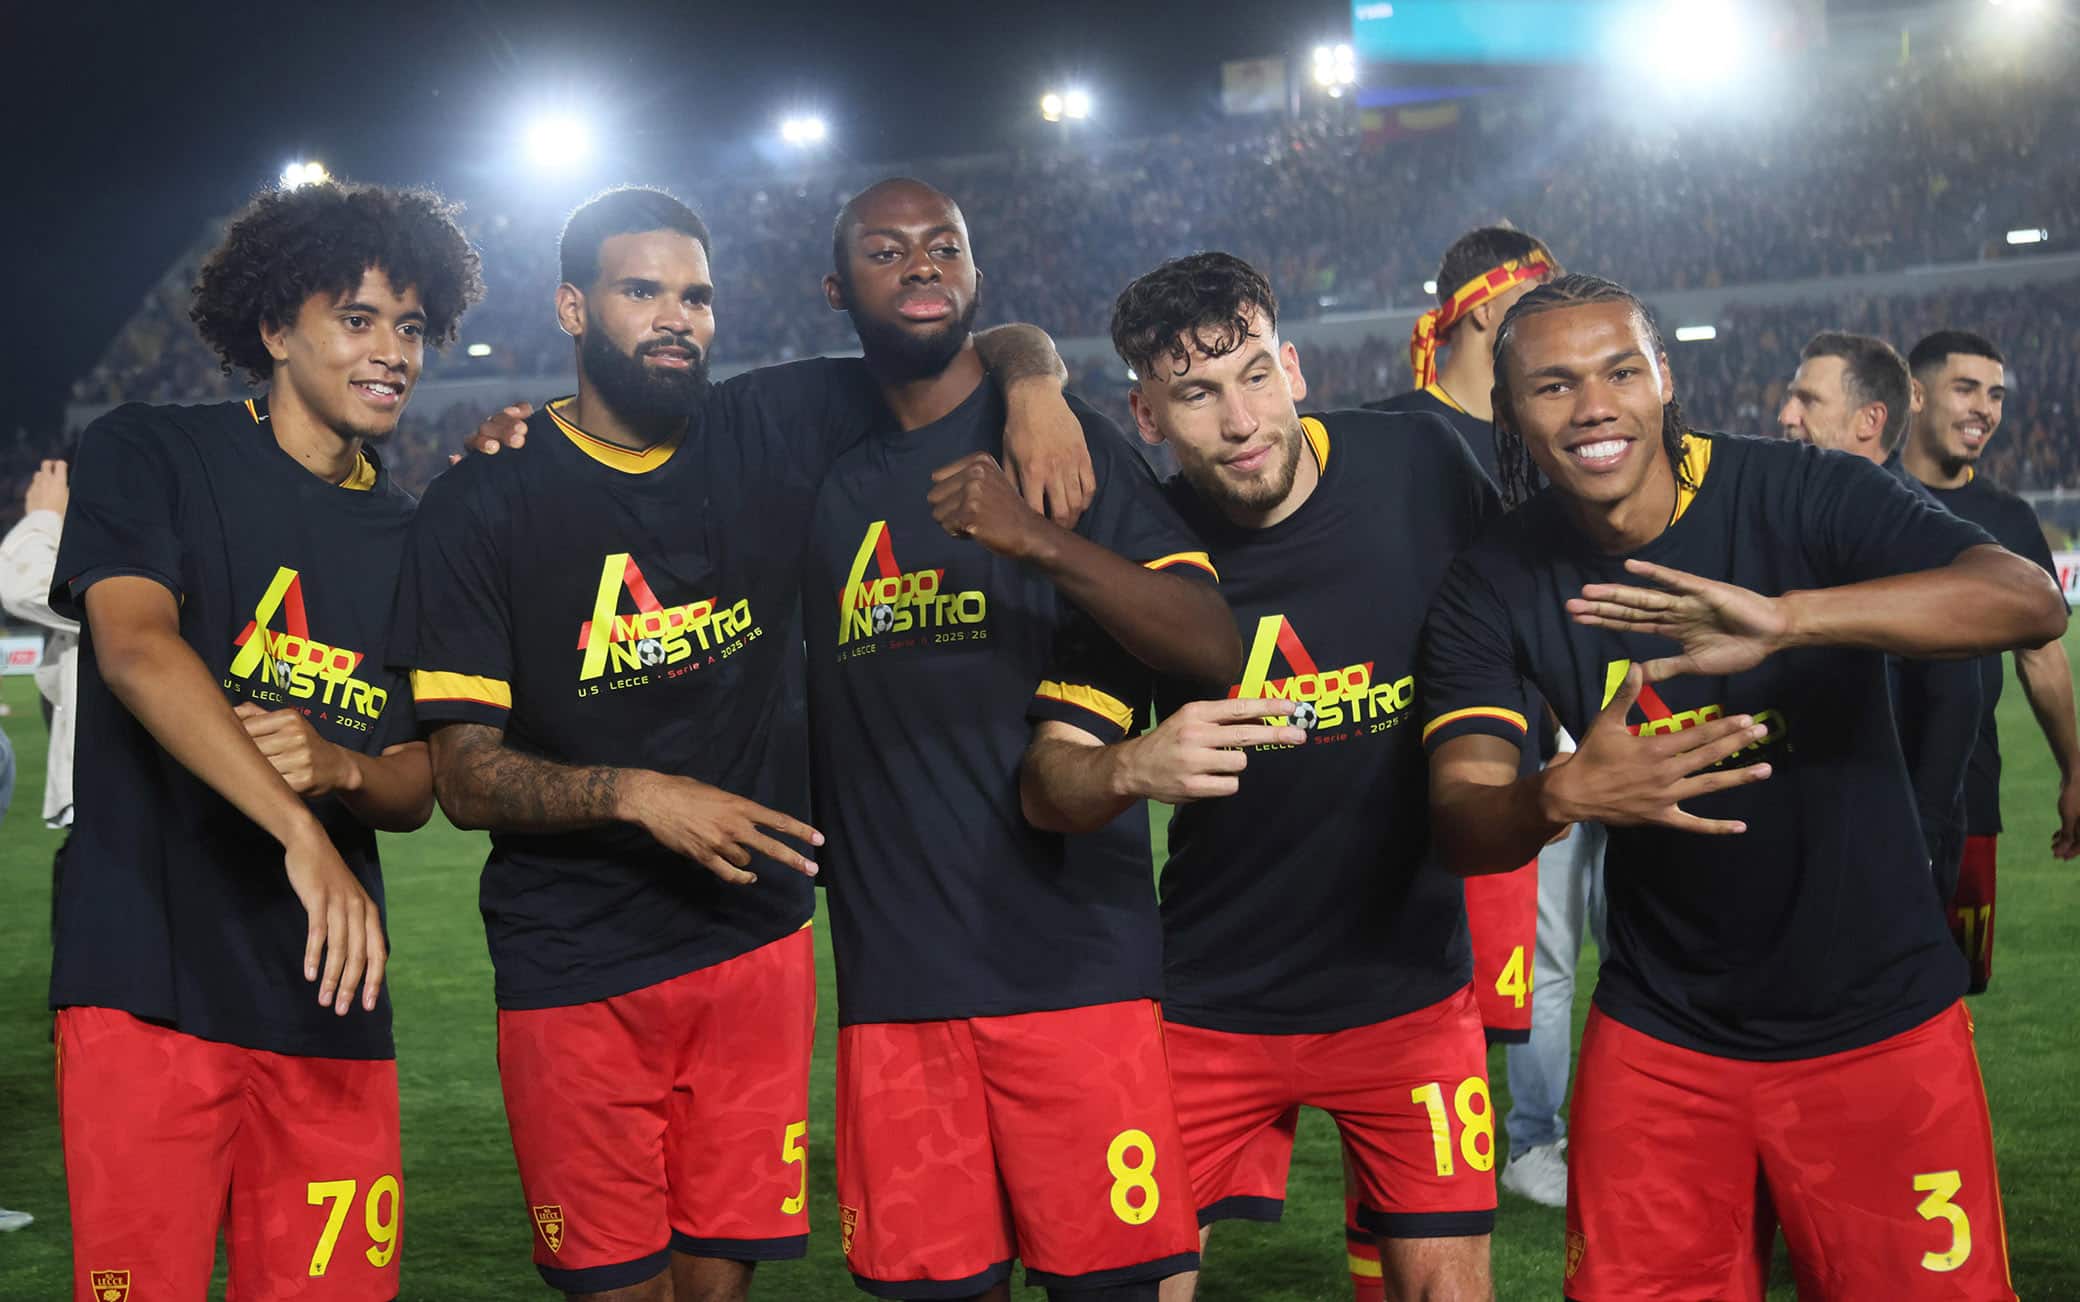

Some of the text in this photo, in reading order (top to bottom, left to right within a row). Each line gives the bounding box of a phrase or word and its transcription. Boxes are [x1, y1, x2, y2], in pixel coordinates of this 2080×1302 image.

[858, 569, 940, 609] MODO
[614, 600, 713, 641] MODO
[264, 628, 356, 678] MODO
[851, 643, 877, 657] LECCE
[609, 675, 649, 690] LECCE
[667, 662, 700, 679] Serie
[1264, 664, 1370, 702] MODO
[1410, 1076, 1495, 1177] 18
[781, 1119, 806, 1215] 5
[1106, 1128, 1160, 1225] 8
[307, 1174, 400, 1277] 79
[1912, 1169, 1972, 1272] 3
